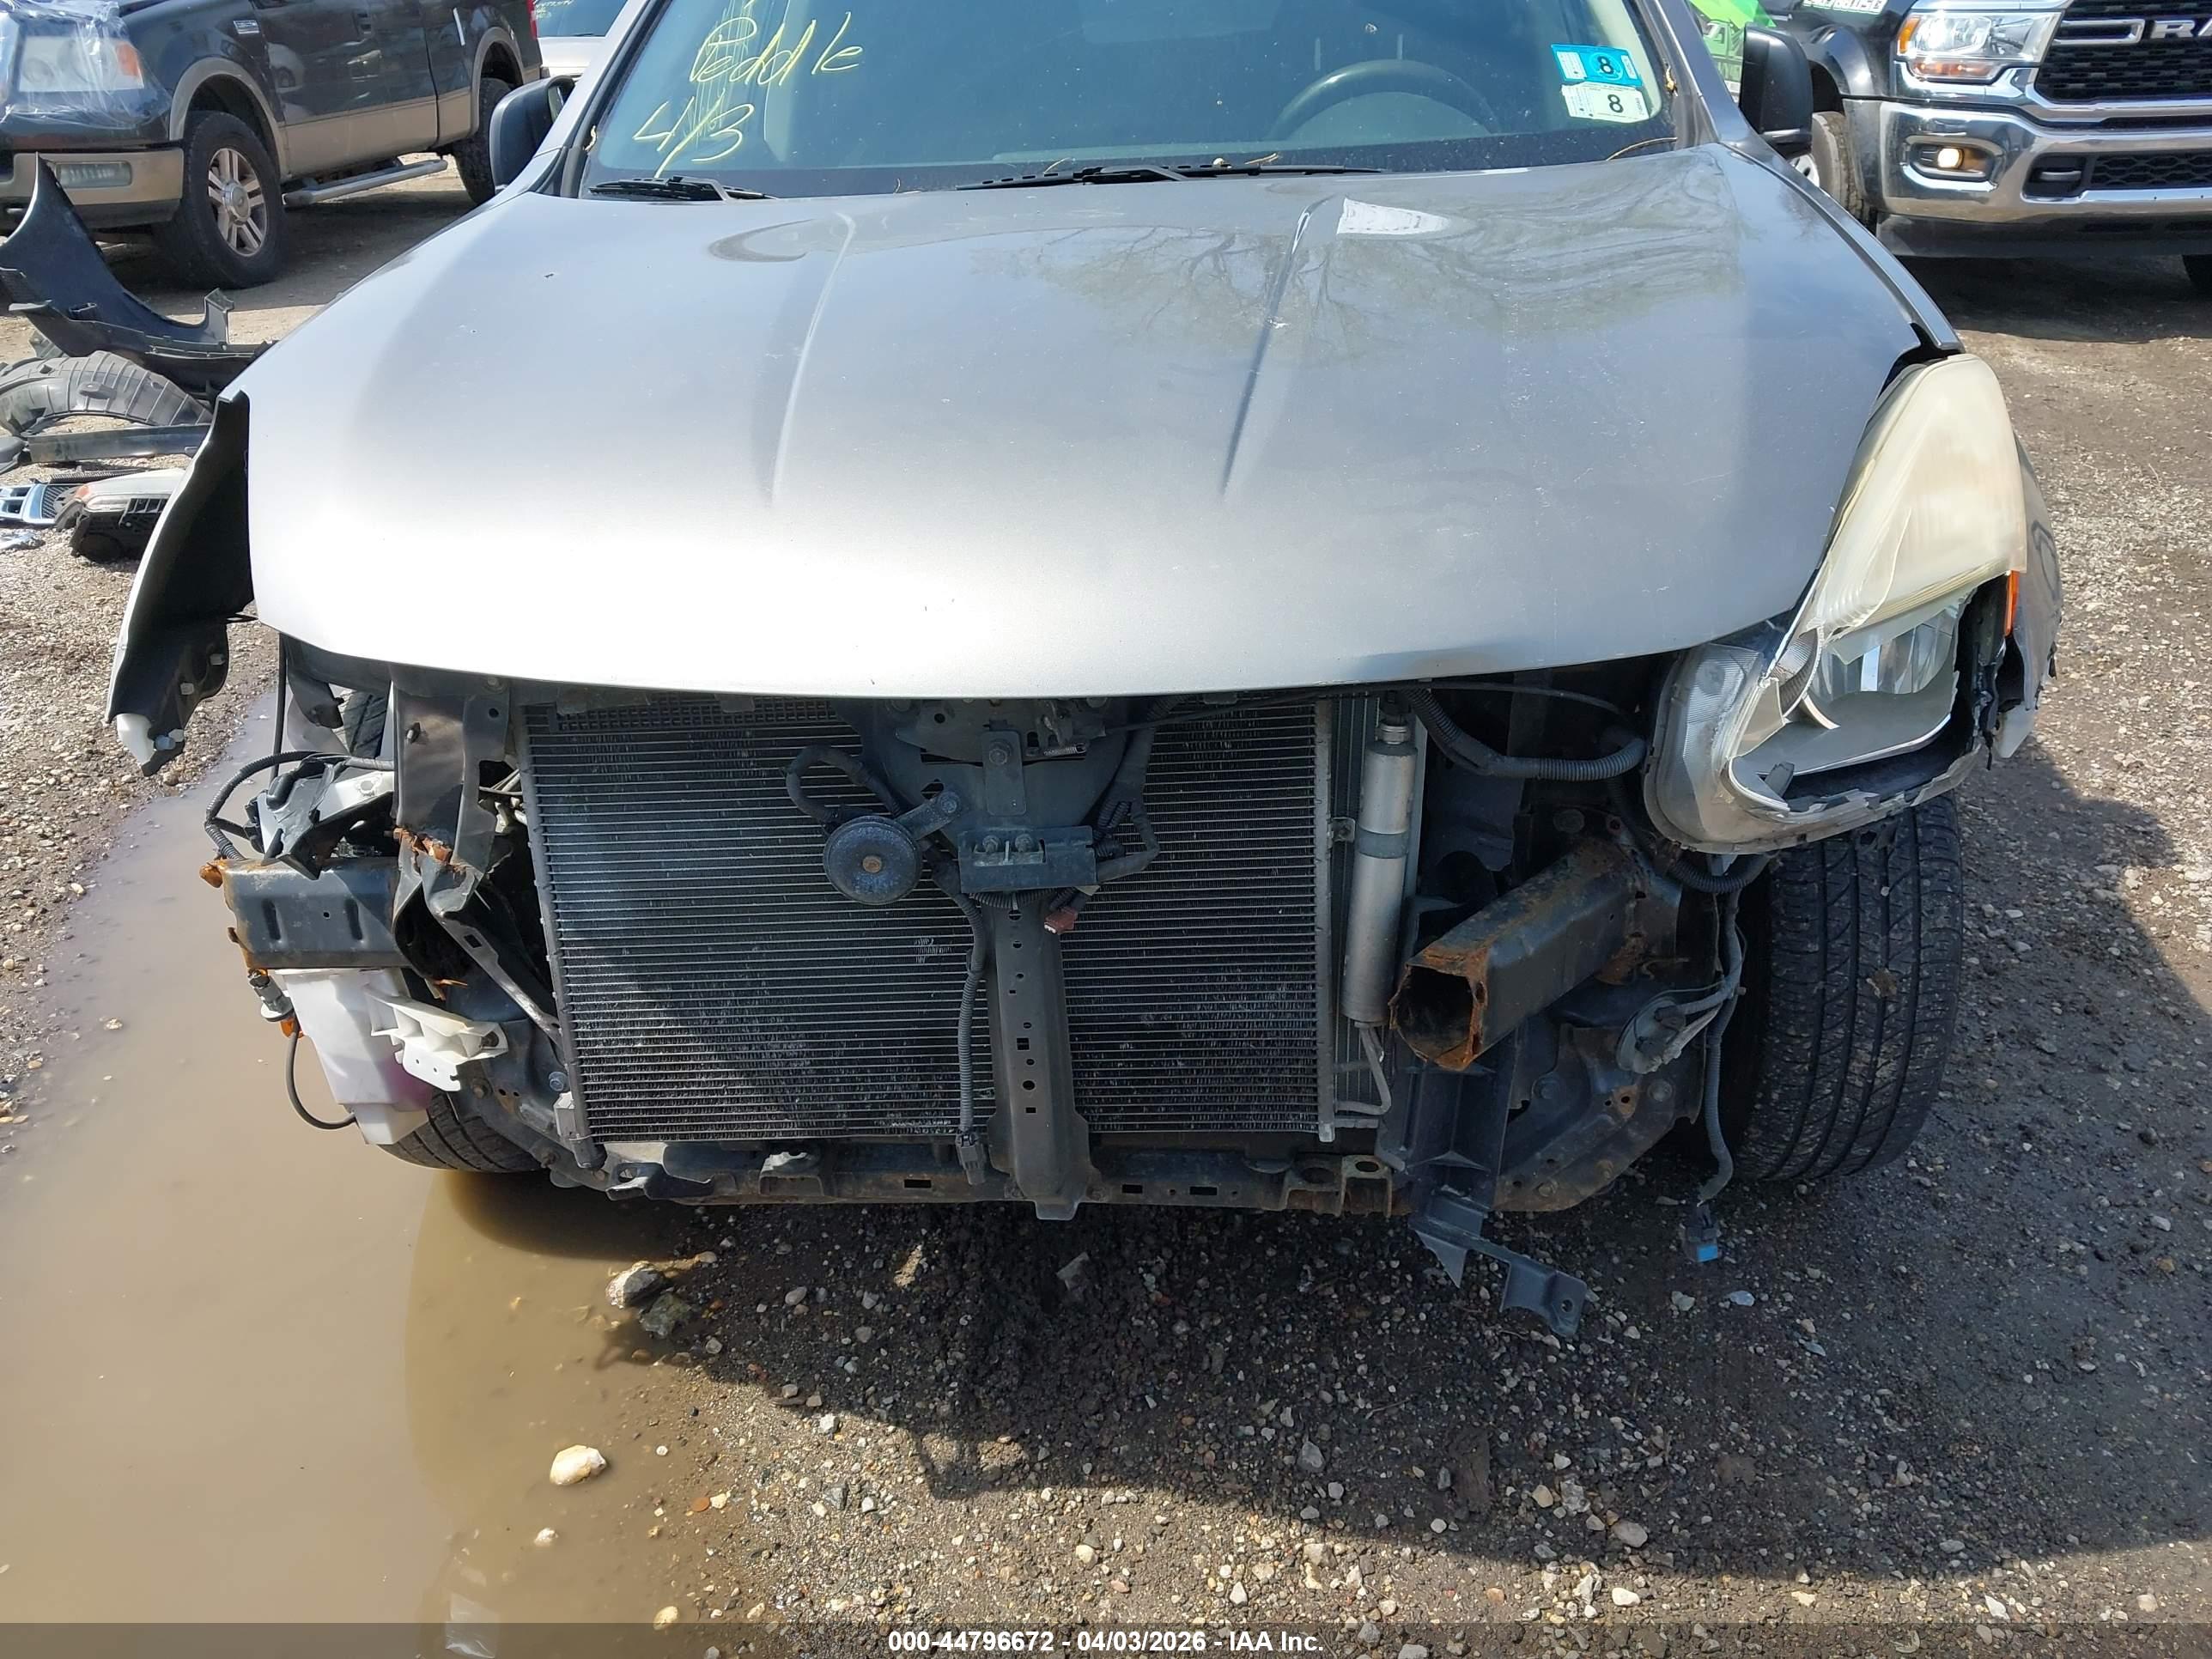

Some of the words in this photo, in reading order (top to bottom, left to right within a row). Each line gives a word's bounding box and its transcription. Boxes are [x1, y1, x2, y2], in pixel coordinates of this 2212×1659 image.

[689, 11, 864, 86] Peddle
[1597, 56, 1614, 75] 8
[1607, 94, 1624, 113] 8
[632, 88, 755, 178] 4/3
